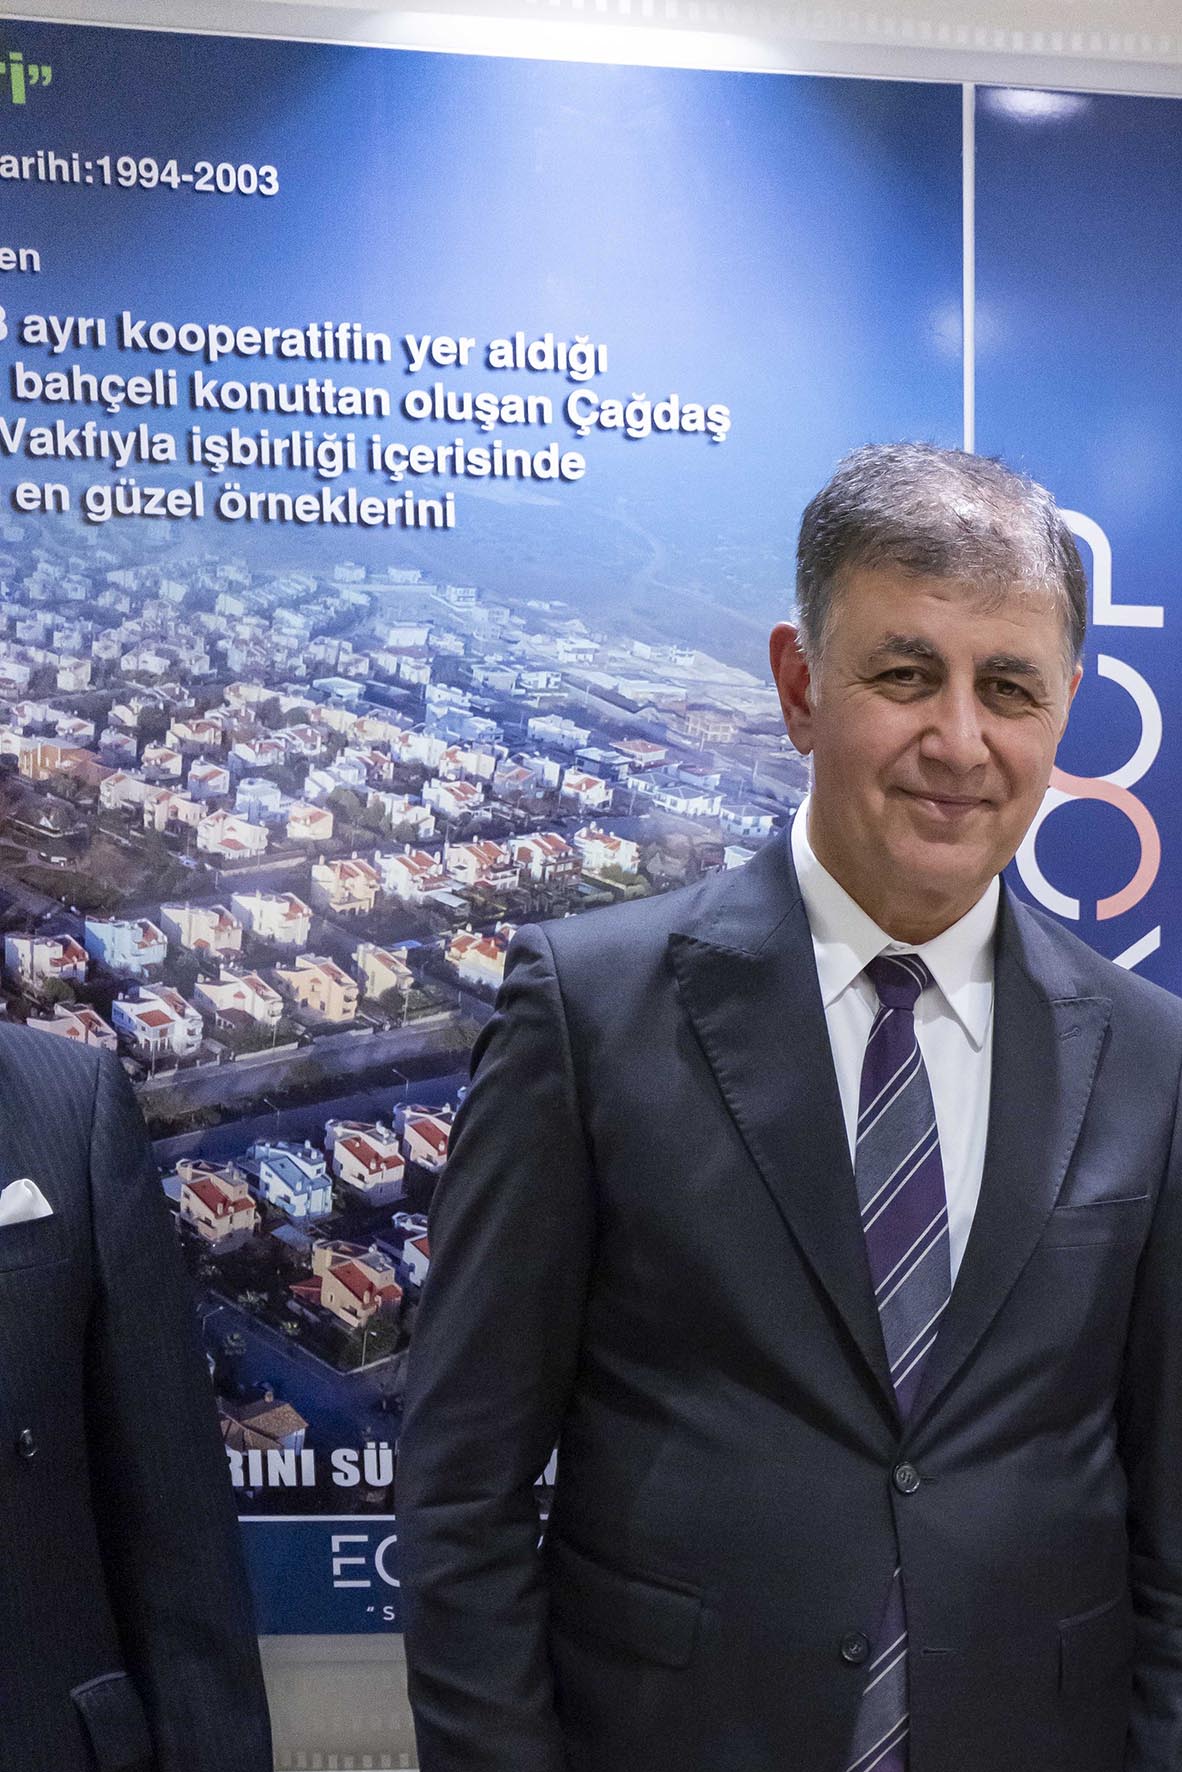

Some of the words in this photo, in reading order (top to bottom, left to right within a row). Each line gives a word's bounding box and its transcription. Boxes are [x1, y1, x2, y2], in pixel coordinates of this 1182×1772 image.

[0, 150, 279, 196] arihi:1994-2003
[0, 247, 41, 272] en
[23, 313, 106, 353] ayrı
[122, 311, 392, 362] kooperatifin
[405, 333, 476, 372] yer
[489, 331, 608, 381] aldığı
[15, 361, 177, 412] bahçeli
[194, 371, 390, 416] konuttan
[405, 382, 552, 431] oluşan
[567, 388, 731, 442] Çağdaş
[0, 416, 177, 467] Vakfıyla
[192, 426, 357, 478] işbirliği
[372, 434, 586, 482] içerisinde
[16, 480, 69, 510] en
[86, 478, 204, 522] güzel
[219, 482, 455, 528] örneklerini
[331, 1441, 399, 1487] SÜ
